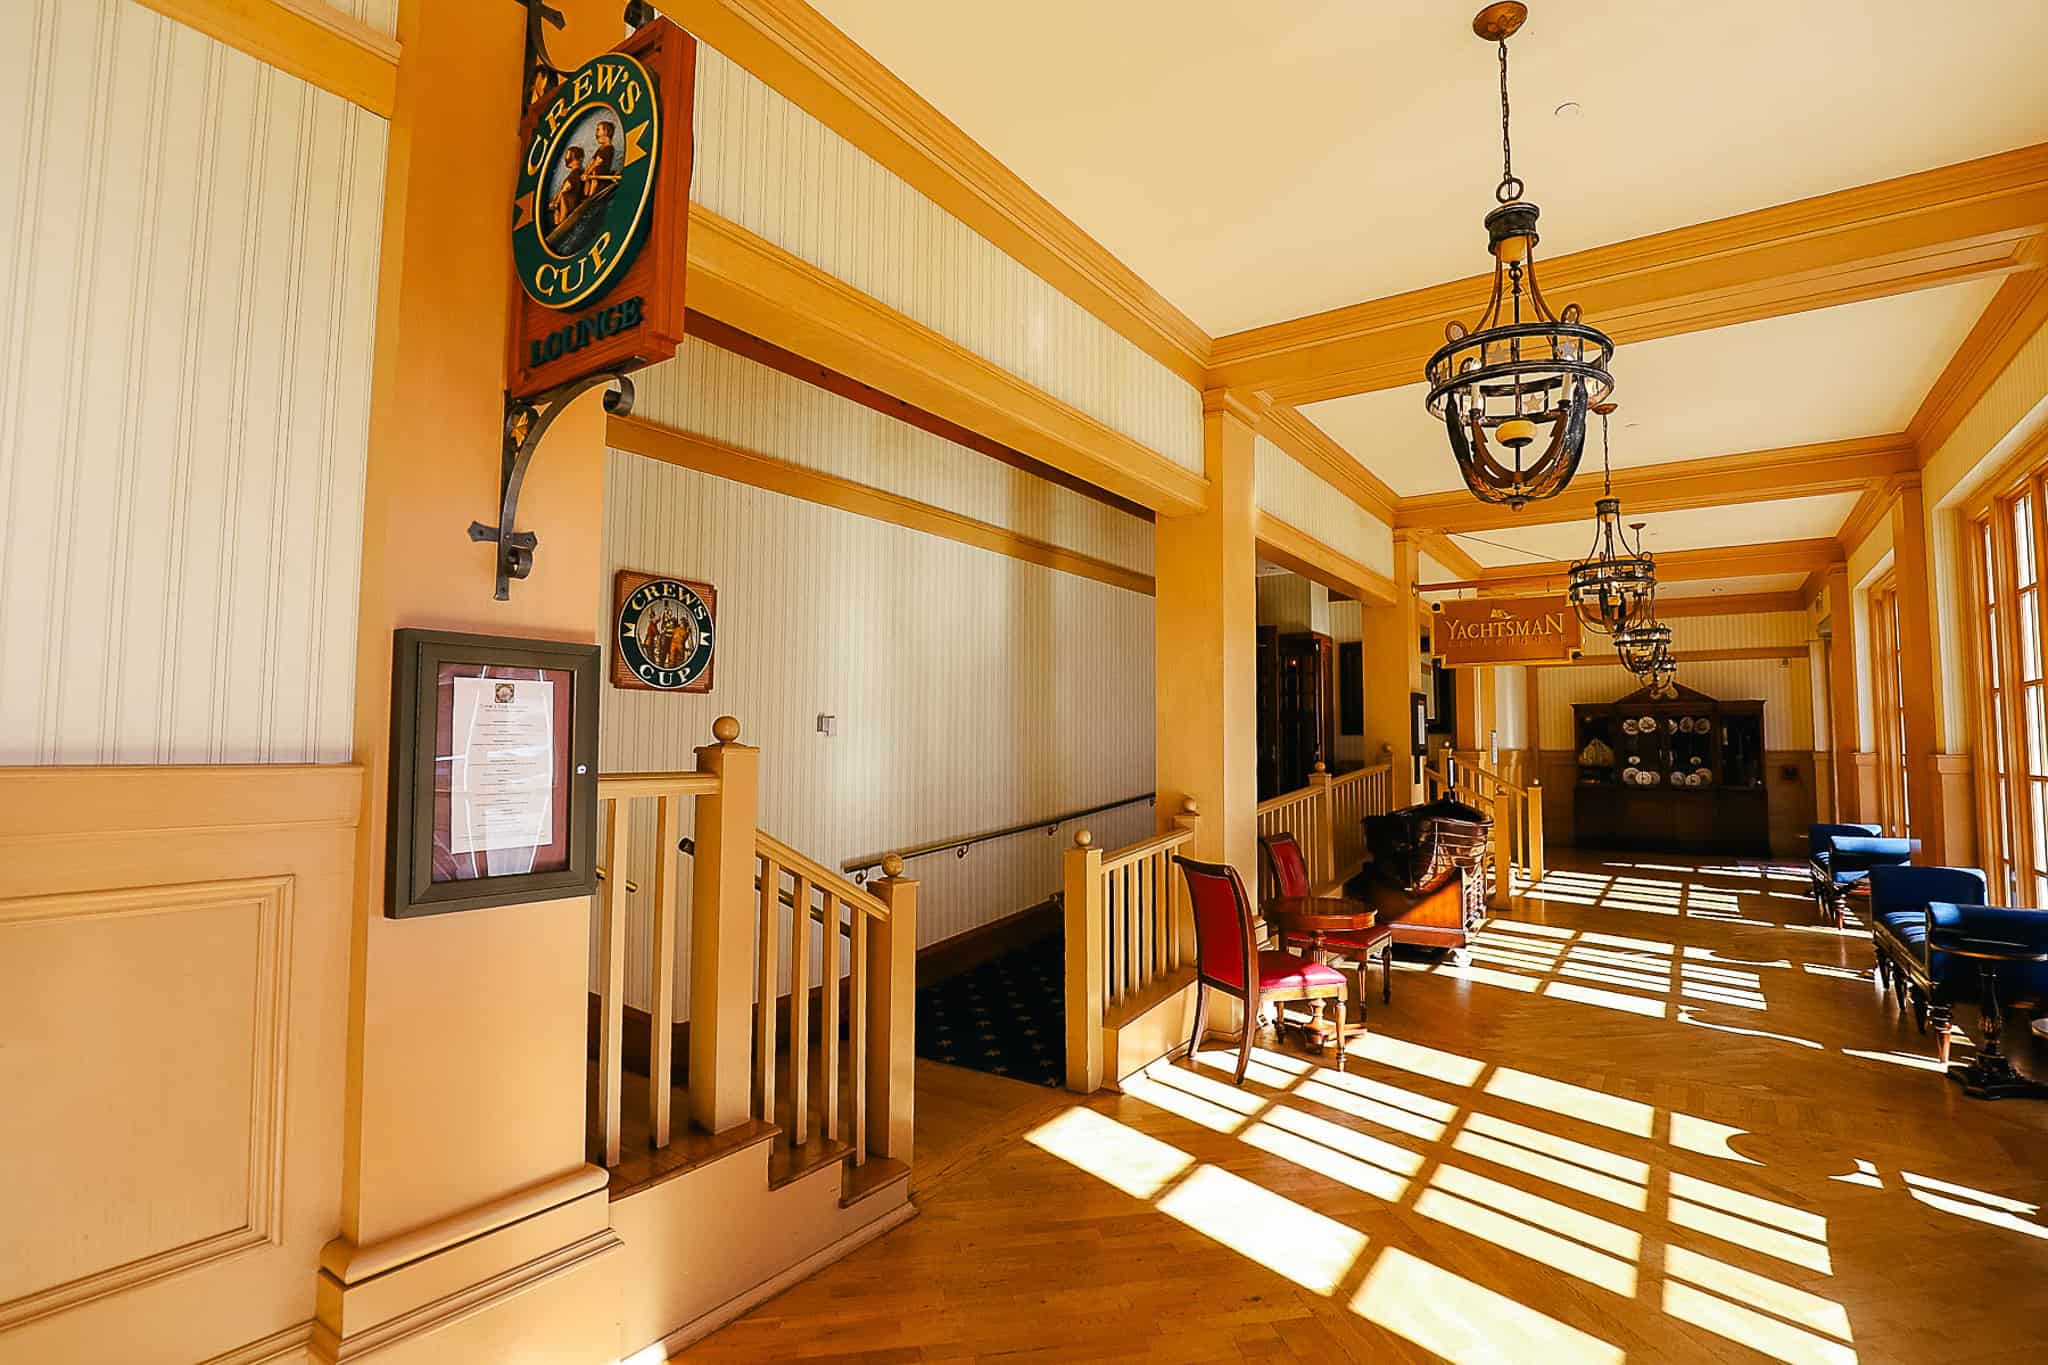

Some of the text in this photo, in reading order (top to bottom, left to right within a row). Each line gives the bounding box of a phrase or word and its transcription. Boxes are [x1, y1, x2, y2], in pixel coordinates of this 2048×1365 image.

[527, 63, 642, 177] CREW'S
[535, 231, 612, 296] CUP
[528, 295, 644, 368] LOUNGE
[631, 583, 707, 620] CREW'S
[1445, 612, 1566, 640] YACHTSMAN
[639, 664, 691, 686] CUP
